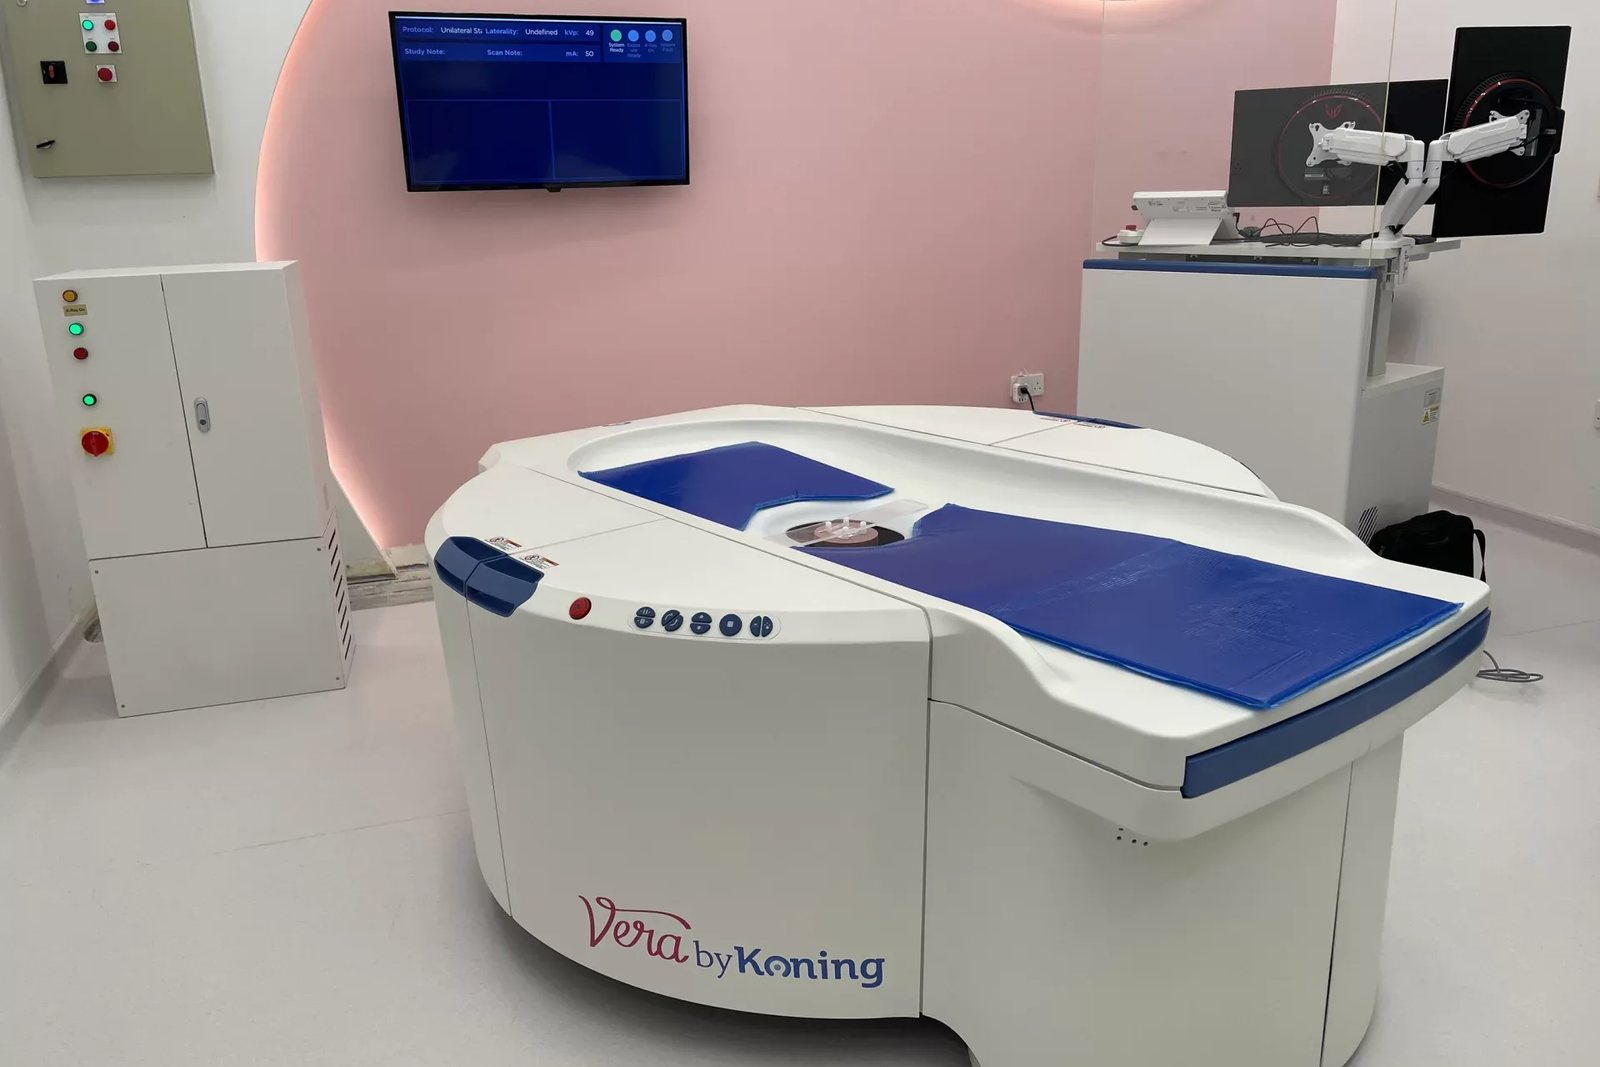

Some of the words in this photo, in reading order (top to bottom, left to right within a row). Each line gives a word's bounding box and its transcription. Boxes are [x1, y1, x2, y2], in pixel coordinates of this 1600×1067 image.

[402, 25, 434, 34] Protocol:
[440, 26, 472, 35] Unilateral
[525, 28, 558, 36] Undefined
[585, 29, 595, 37] 49
[404, 47, 425, 56] Study
[427, 47, 446, 55] Note:
[505, 49, 523, 57] Note:
[578, 895, 692, 963] Vera
[692, 940, 733, 979] by
[734, 945, 885, 988] Koning
